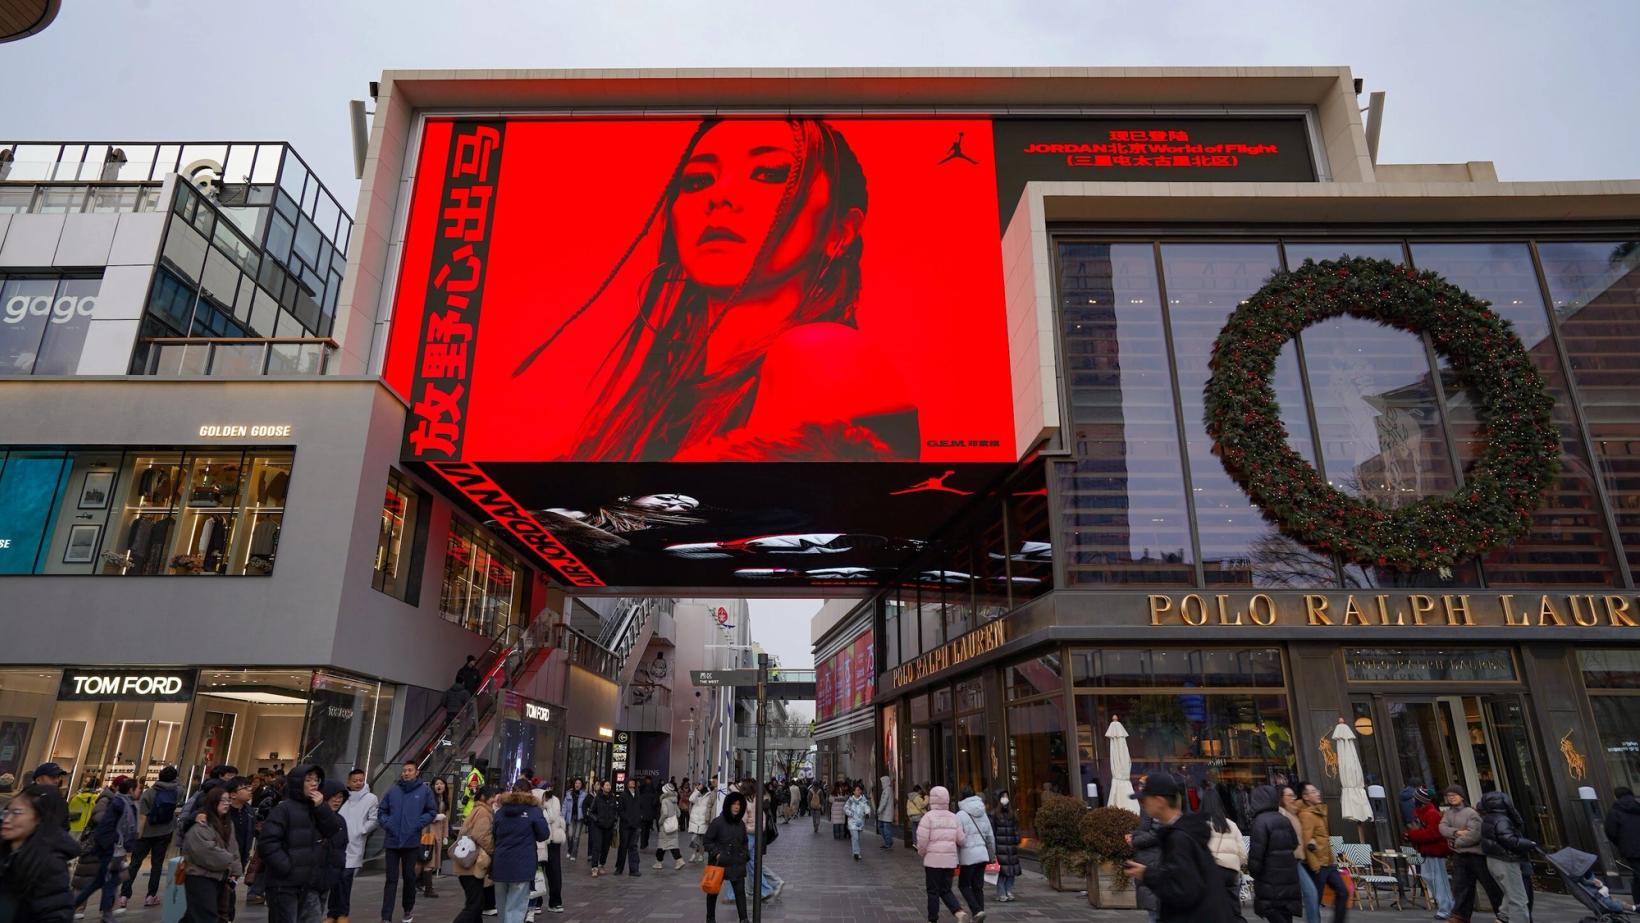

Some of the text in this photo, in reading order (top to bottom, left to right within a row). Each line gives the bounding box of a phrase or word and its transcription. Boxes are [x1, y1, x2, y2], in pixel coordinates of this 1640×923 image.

[1148, 143, 1203, 153] World
[1207, 143, 1223, 153] of
[1225, 143, 1279, 156] Flight
[409, 125, 500, 456] 放野心出马
[3, 295, 97, 324] gaga
[199, 425, 291, 437] GOLDEN GOOSE
[467, 490, 576, 564] JORDAN
[0, 539, 11, 549] SE
[1148, 593, 1640, 626] POLO RALPH LAUR
[893, 661, 913, 688] POLO
[916, 643, 949, 680] RALPH
[953, 618, 1006, 664] LAUREN
[74, 676, 182, 694] TOM FORD
[526, 703, 550, 721] TOM FORD
